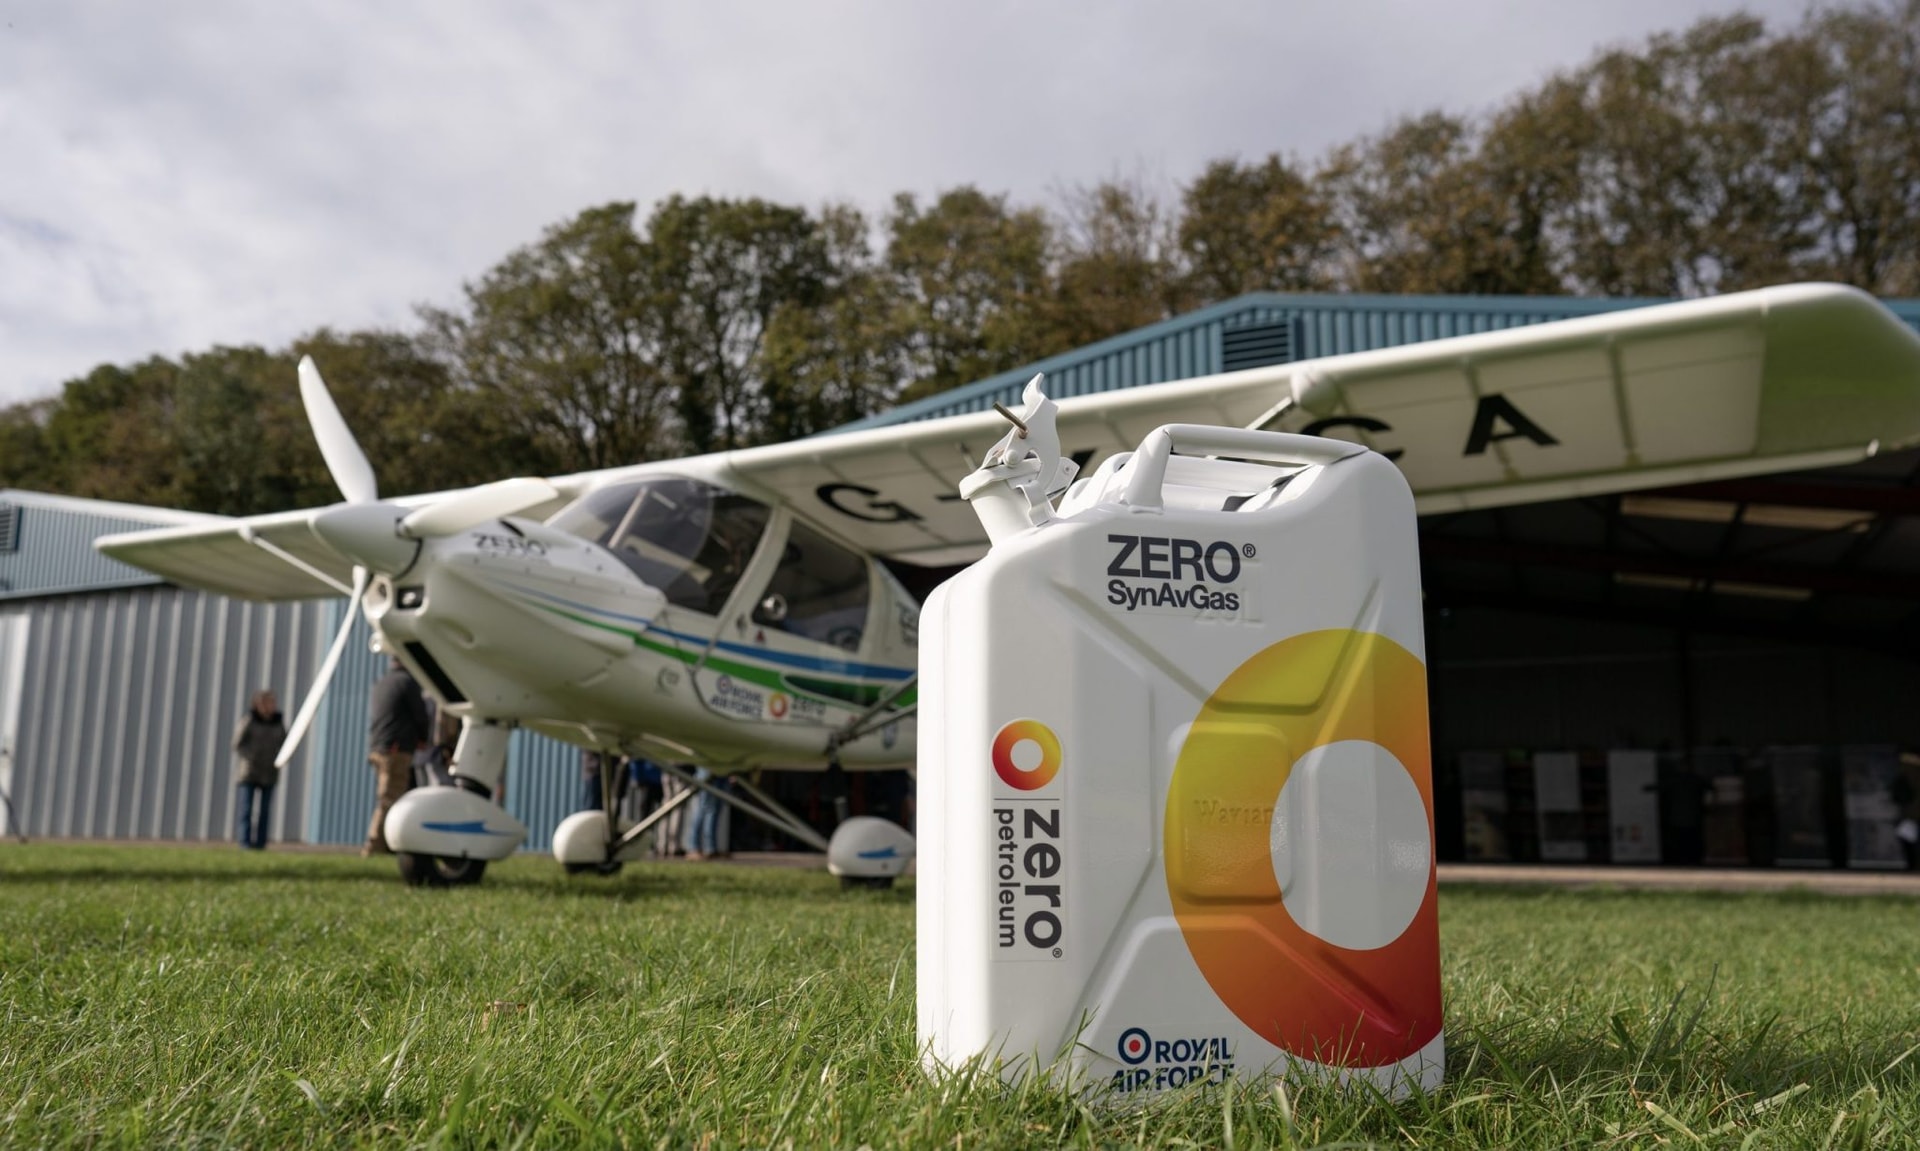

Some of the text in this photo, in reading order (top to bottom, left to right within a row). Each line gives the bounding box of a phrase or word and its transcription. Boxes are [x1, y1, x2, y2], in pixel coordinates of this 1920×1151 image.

[1107, 579, 1240, 611] SynAvGas
[993, 808, 1021, 948] petroleum
[1155, 1038, 1232, 1063] ROYAL
